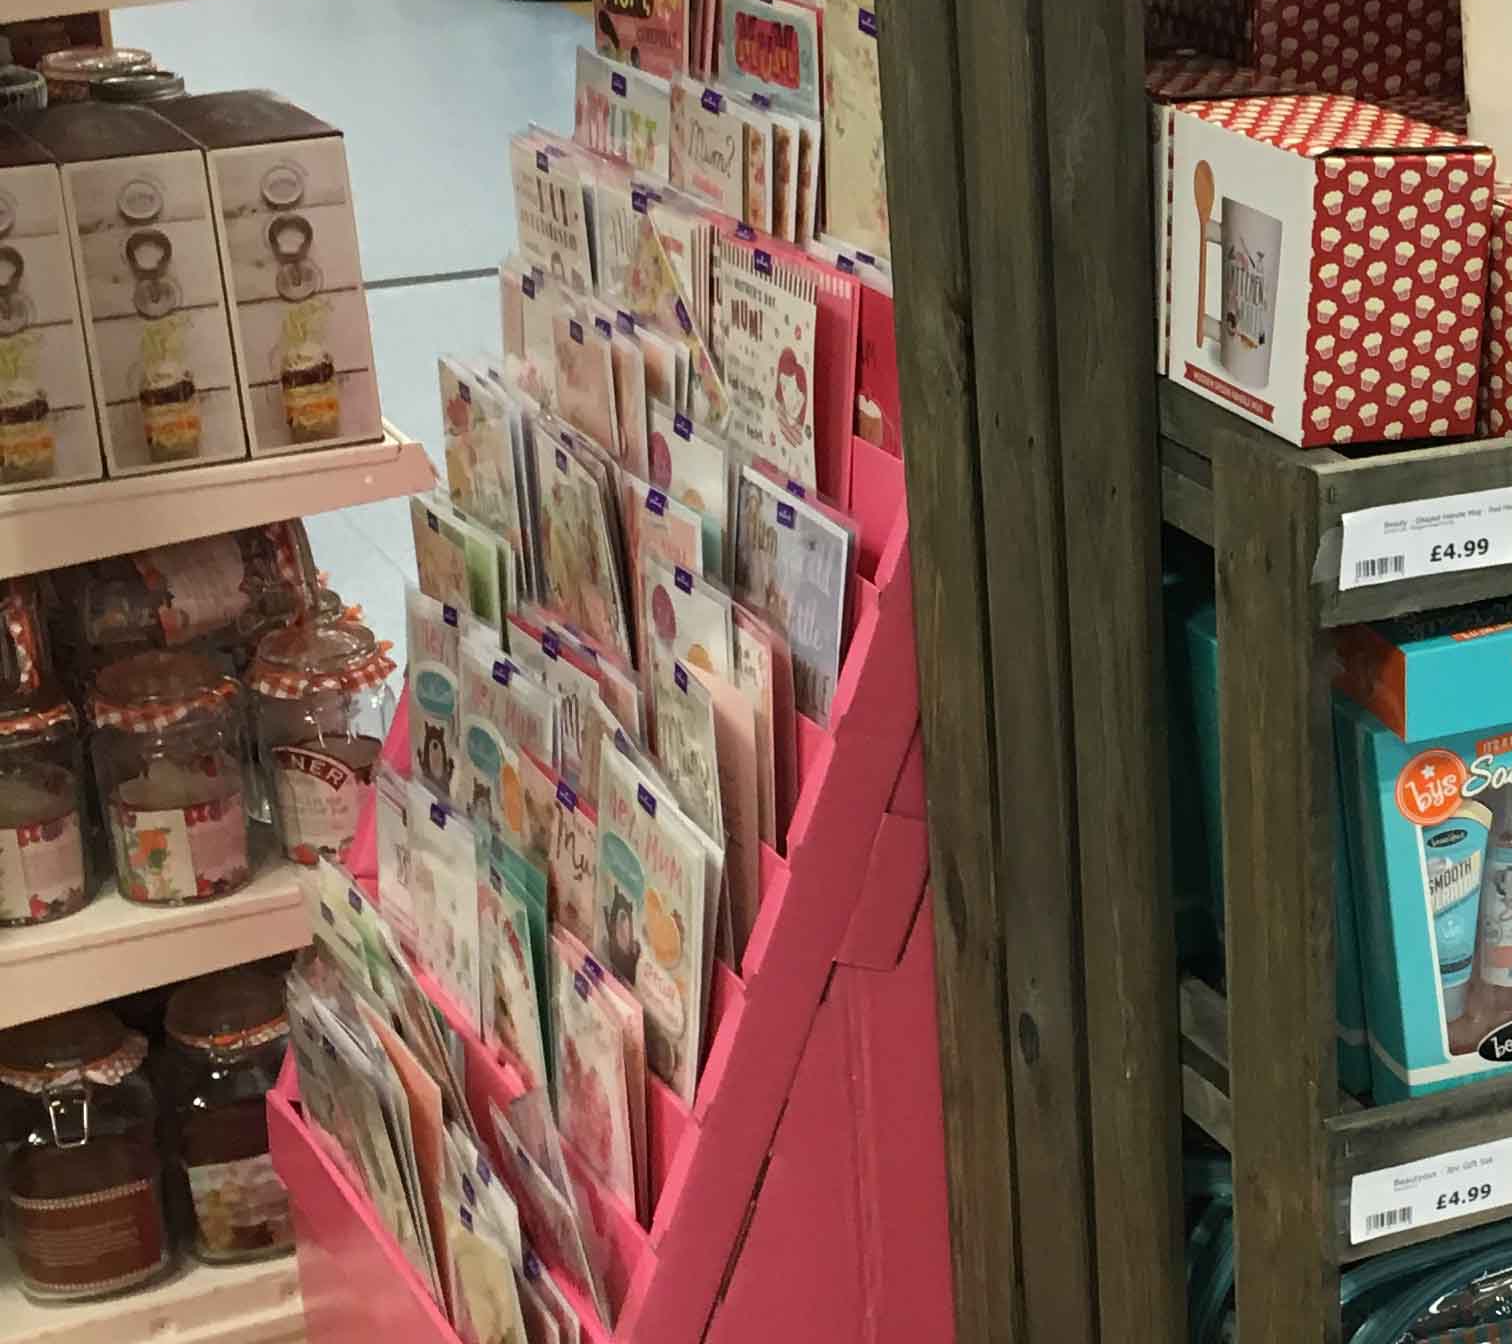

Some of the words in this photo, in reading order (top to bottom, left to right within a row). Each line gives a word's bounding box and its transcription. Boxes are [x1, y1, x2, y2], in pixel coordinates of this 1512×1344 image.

[730, 298, 765, 342] MUM!
[1429, 537, 1490, 563] £4.99
[1435, 1183, 1492, 1211] £4.99
